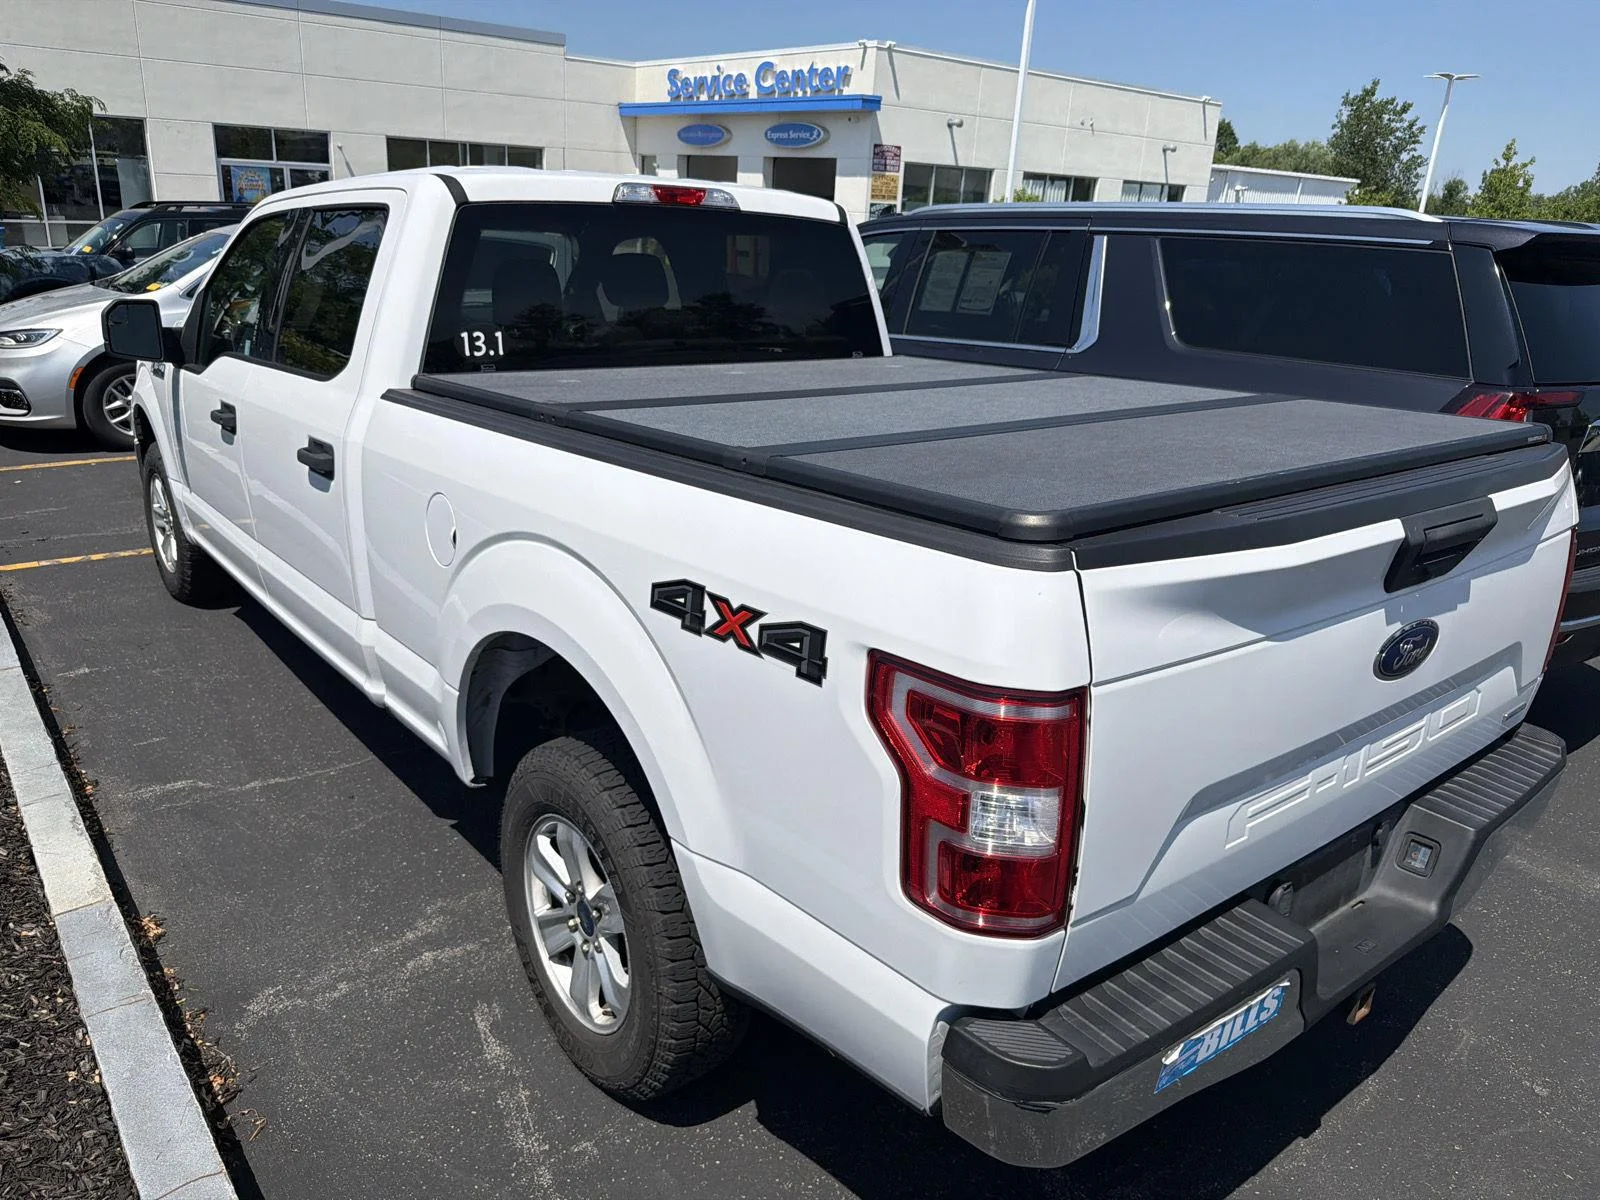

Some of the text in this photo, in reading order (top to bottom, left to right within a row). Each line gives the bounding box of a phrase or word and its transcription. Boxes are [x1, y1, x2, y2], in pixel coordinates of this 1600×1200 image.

[667, 60, 851, 99] Service Center
[766, 129, 811, 141] Express Service
[460, 331, 504, 357] 13.1
[1225, 687, 1482, 849] F-150
[1194, 986, 1283, 1065] BILLS
